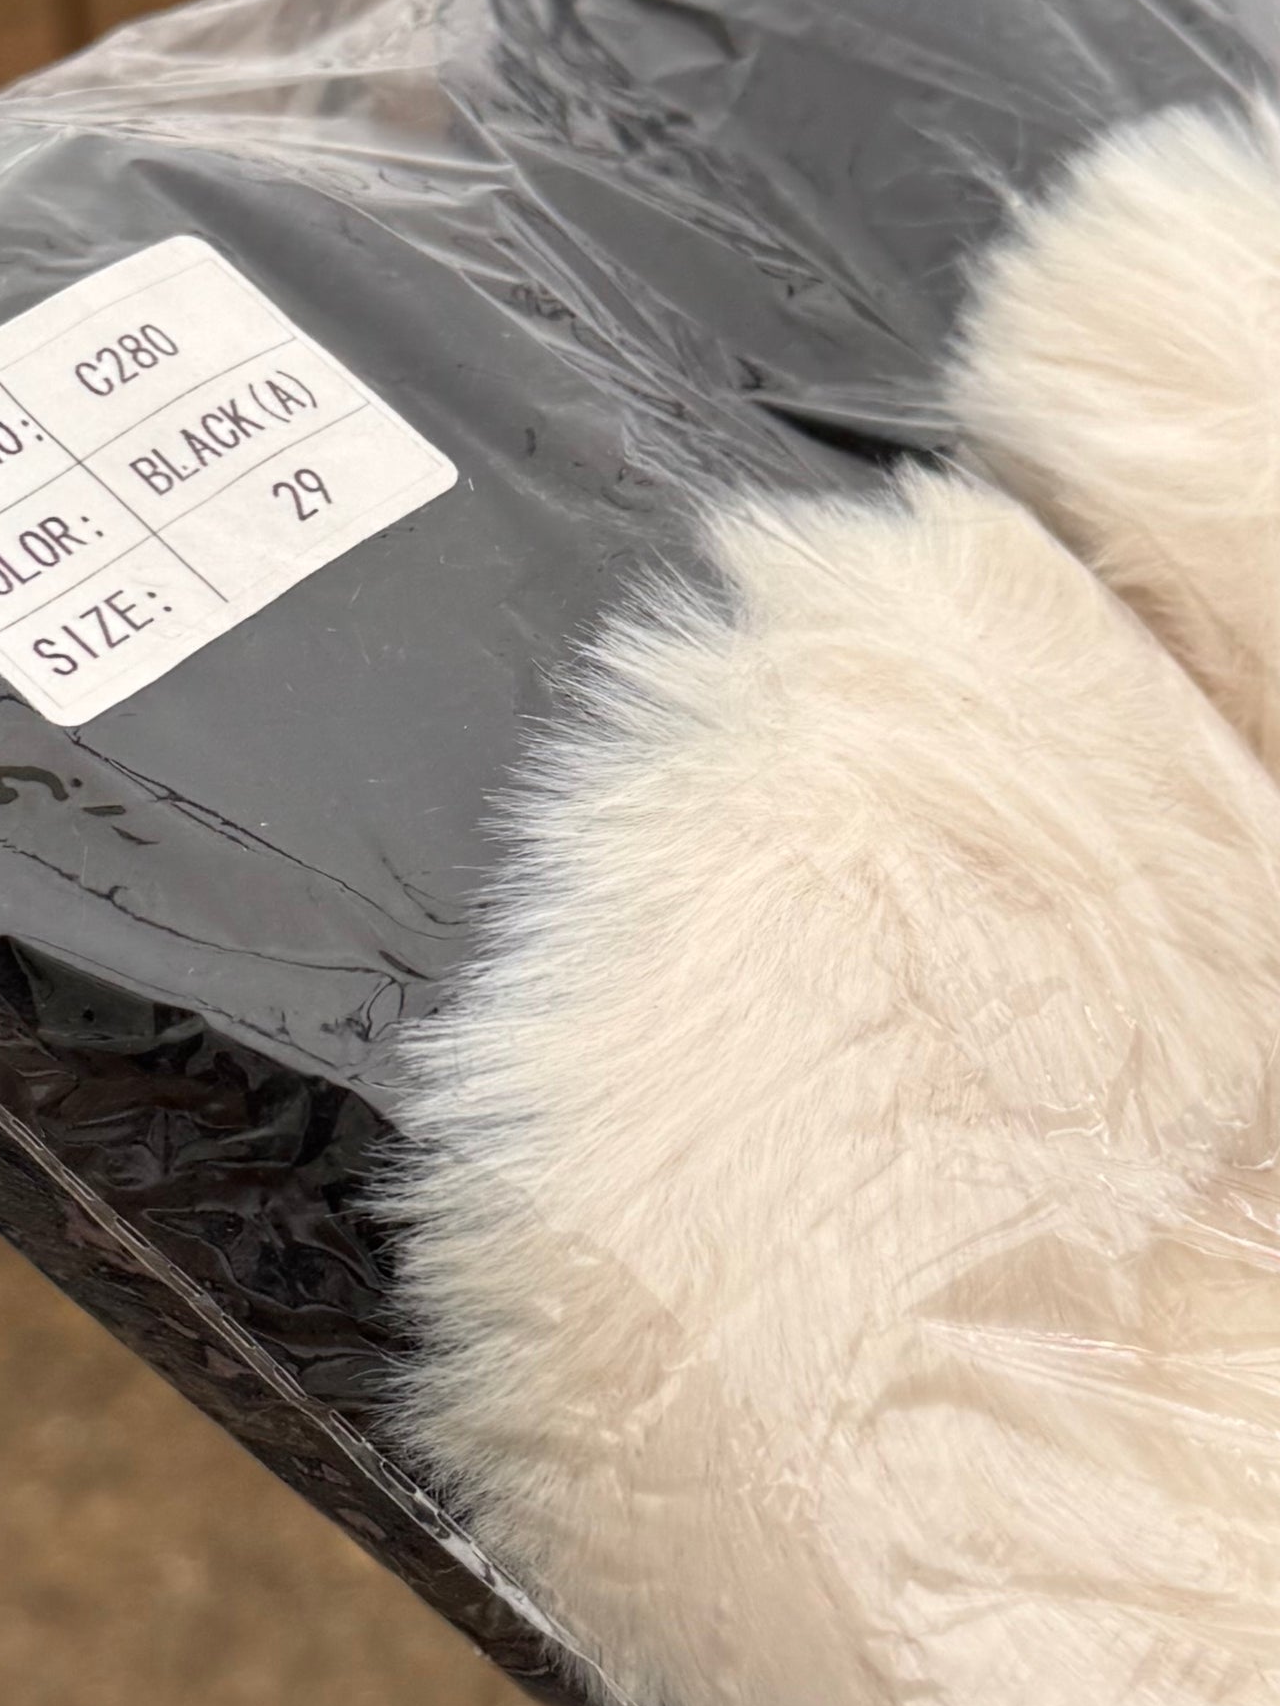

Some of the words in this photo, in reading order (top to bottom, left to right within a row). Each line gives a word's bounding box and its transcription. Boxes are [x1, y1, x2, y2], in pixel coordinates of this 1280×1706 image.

[75, 324, 179, 397] C280
[129, 370, 318, 495] BLACK(A)
[32, 590, 173, 676] SIZE:
[273, 467, 334, 521] 29
